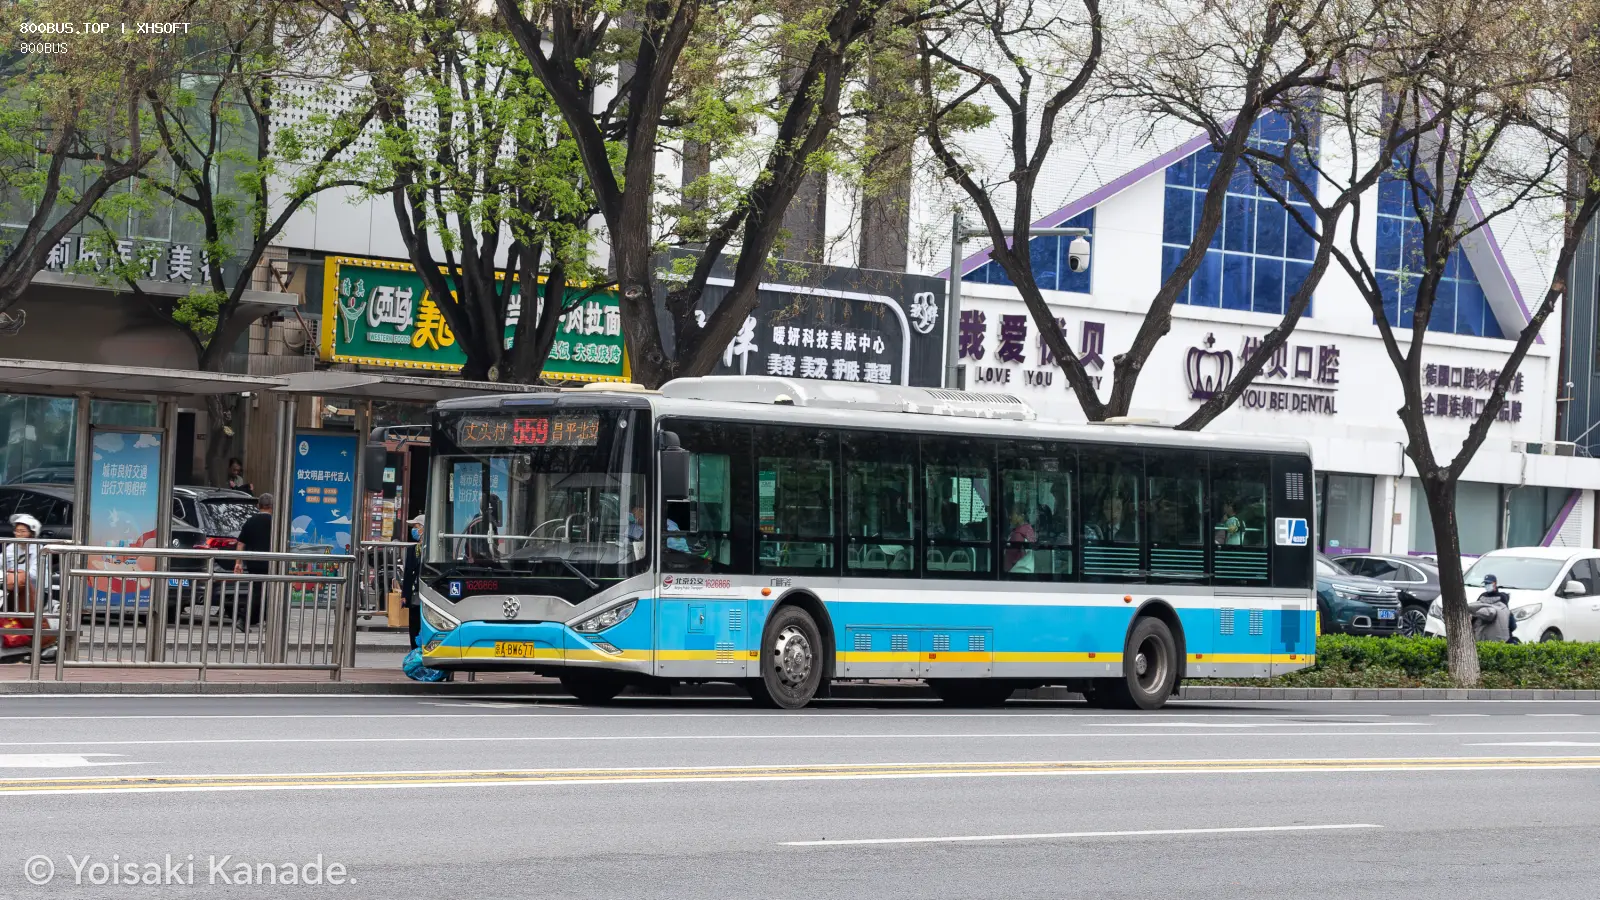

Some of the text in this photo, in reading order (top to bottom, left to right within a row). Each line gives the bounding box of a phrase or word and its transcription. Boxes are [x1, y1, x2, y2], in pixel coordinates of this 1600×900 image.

[368, 332, 411, 345] WESTERN FOODS
[772, 326, 885, 354] 暖妍科技美肤中心
[767, 353, 892, 384] 美容 美发 护肤 造型
[976, 366, 1011, 384] LOVE
[1024, 370, 1053, 387] YOU
[1424, 363, 1524, 394] 德国口腔诊疗准
[1240, 389, 1338, 414] YOU BEI DENTAL
[1423, 392, 1523, 423] 全国连锁口品牌
[513, 418, 549, 444] 559
[102, 463, 148, 479] 城市良好交通
[297, 469, 351, 482] 做文明昌平代言人
[101, 480, 147, 496] 出行文明相伴
[675, 577, 704, 585] 北京公交
